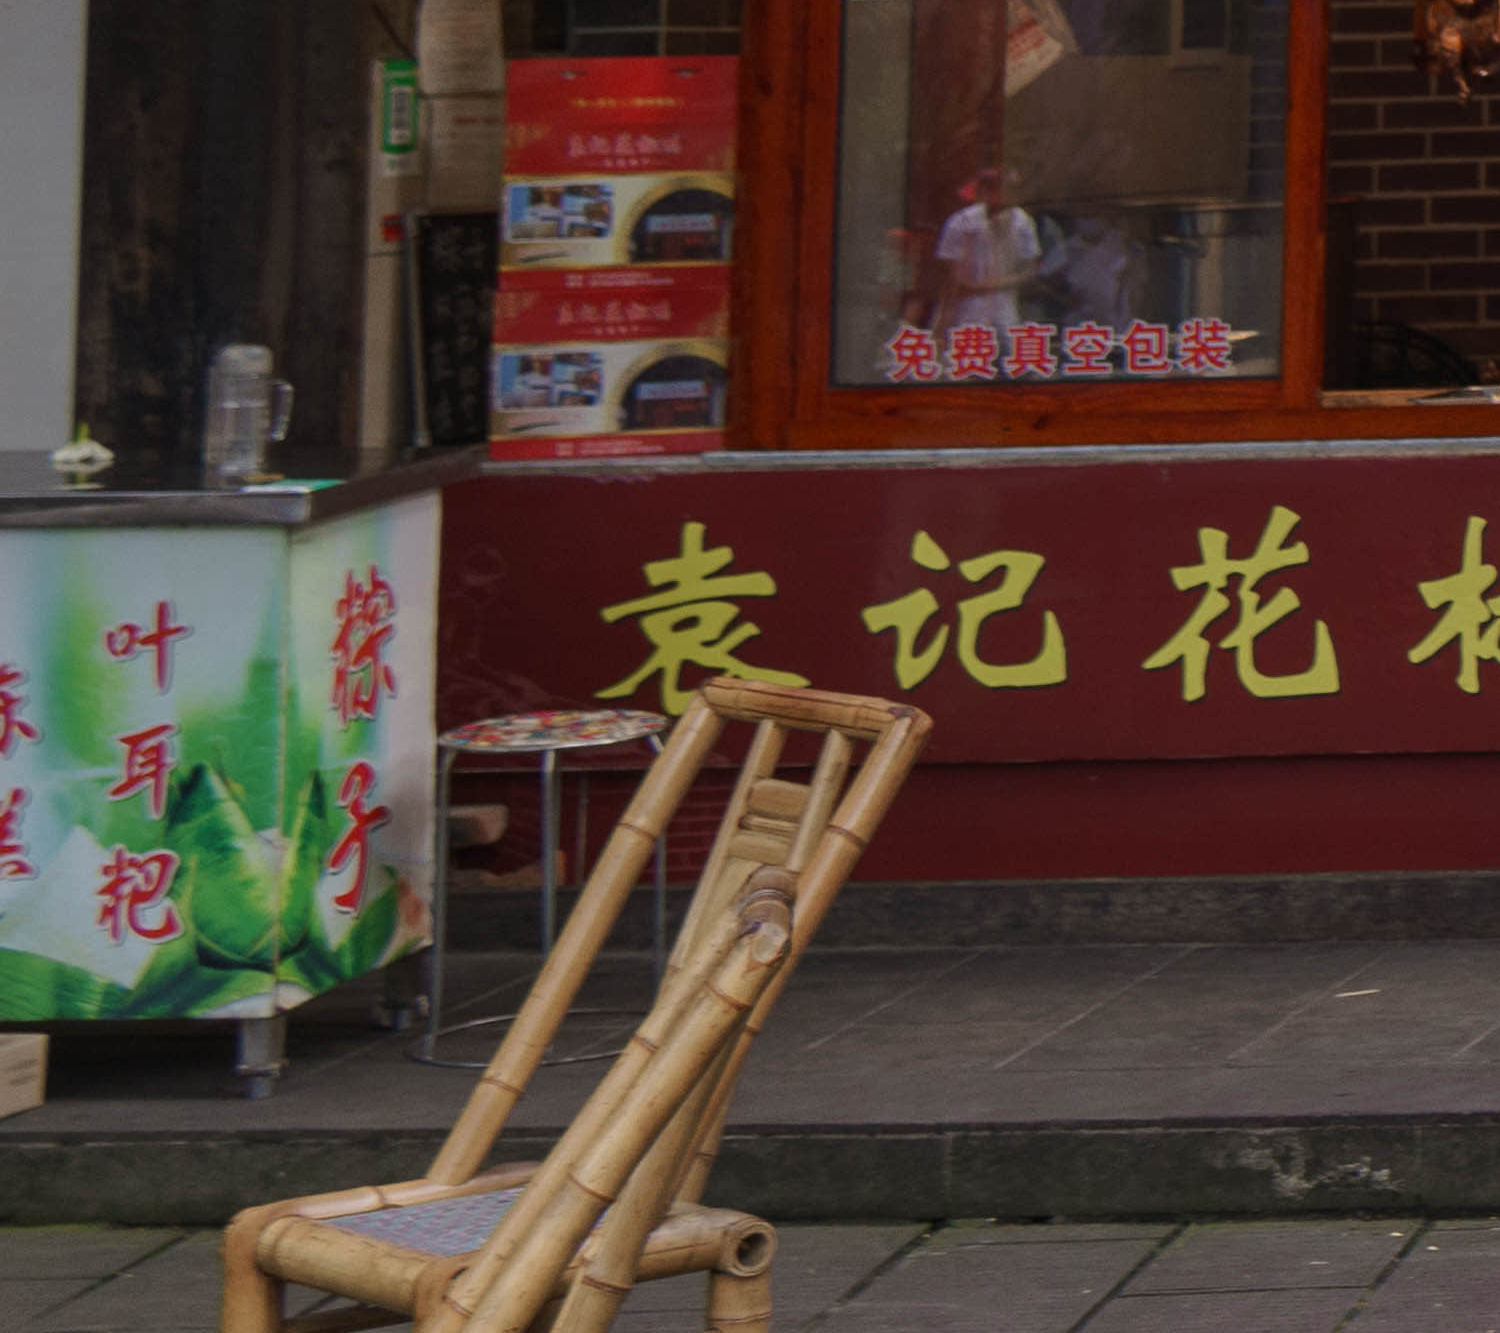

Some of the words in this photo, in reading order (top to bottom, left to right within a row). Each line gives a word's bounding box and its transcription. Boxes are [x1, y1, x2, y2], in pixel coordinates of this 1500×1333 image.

[888, 317, 1233, 382] 免费真空包装
[97, 600, 191, 944] 叶耳粑
